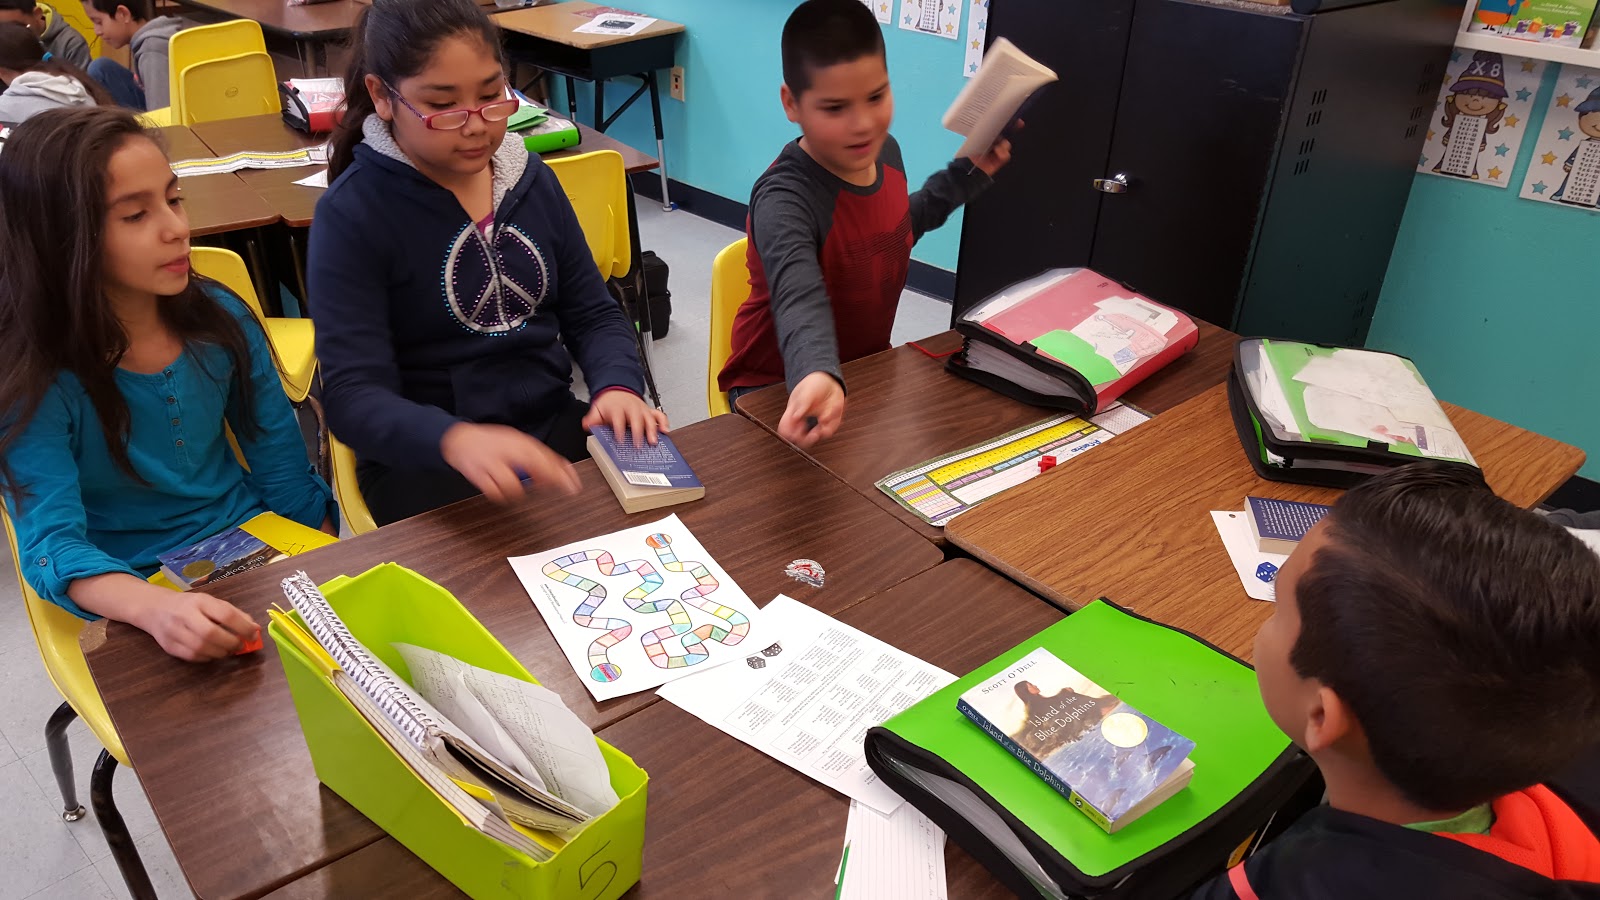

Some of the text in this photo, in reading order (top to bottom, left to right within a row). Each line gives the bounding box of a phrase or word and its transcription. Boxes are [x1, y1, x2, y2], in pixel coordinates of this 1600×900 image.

[1490, 63, 1501, 78] 8
[981, 660, 1038, 695] SCOTT O'DELL
[1029, 696, 1077, 728] Island of the
[1034, 699, 1096, 741] Blue Dolphins
[982, 720, 1004, 743] Island
[1016, 748, 1032, 766] Blue
[1033, 761, 1066, 793] Dolphins
[578, 840, 618, 900] 5
